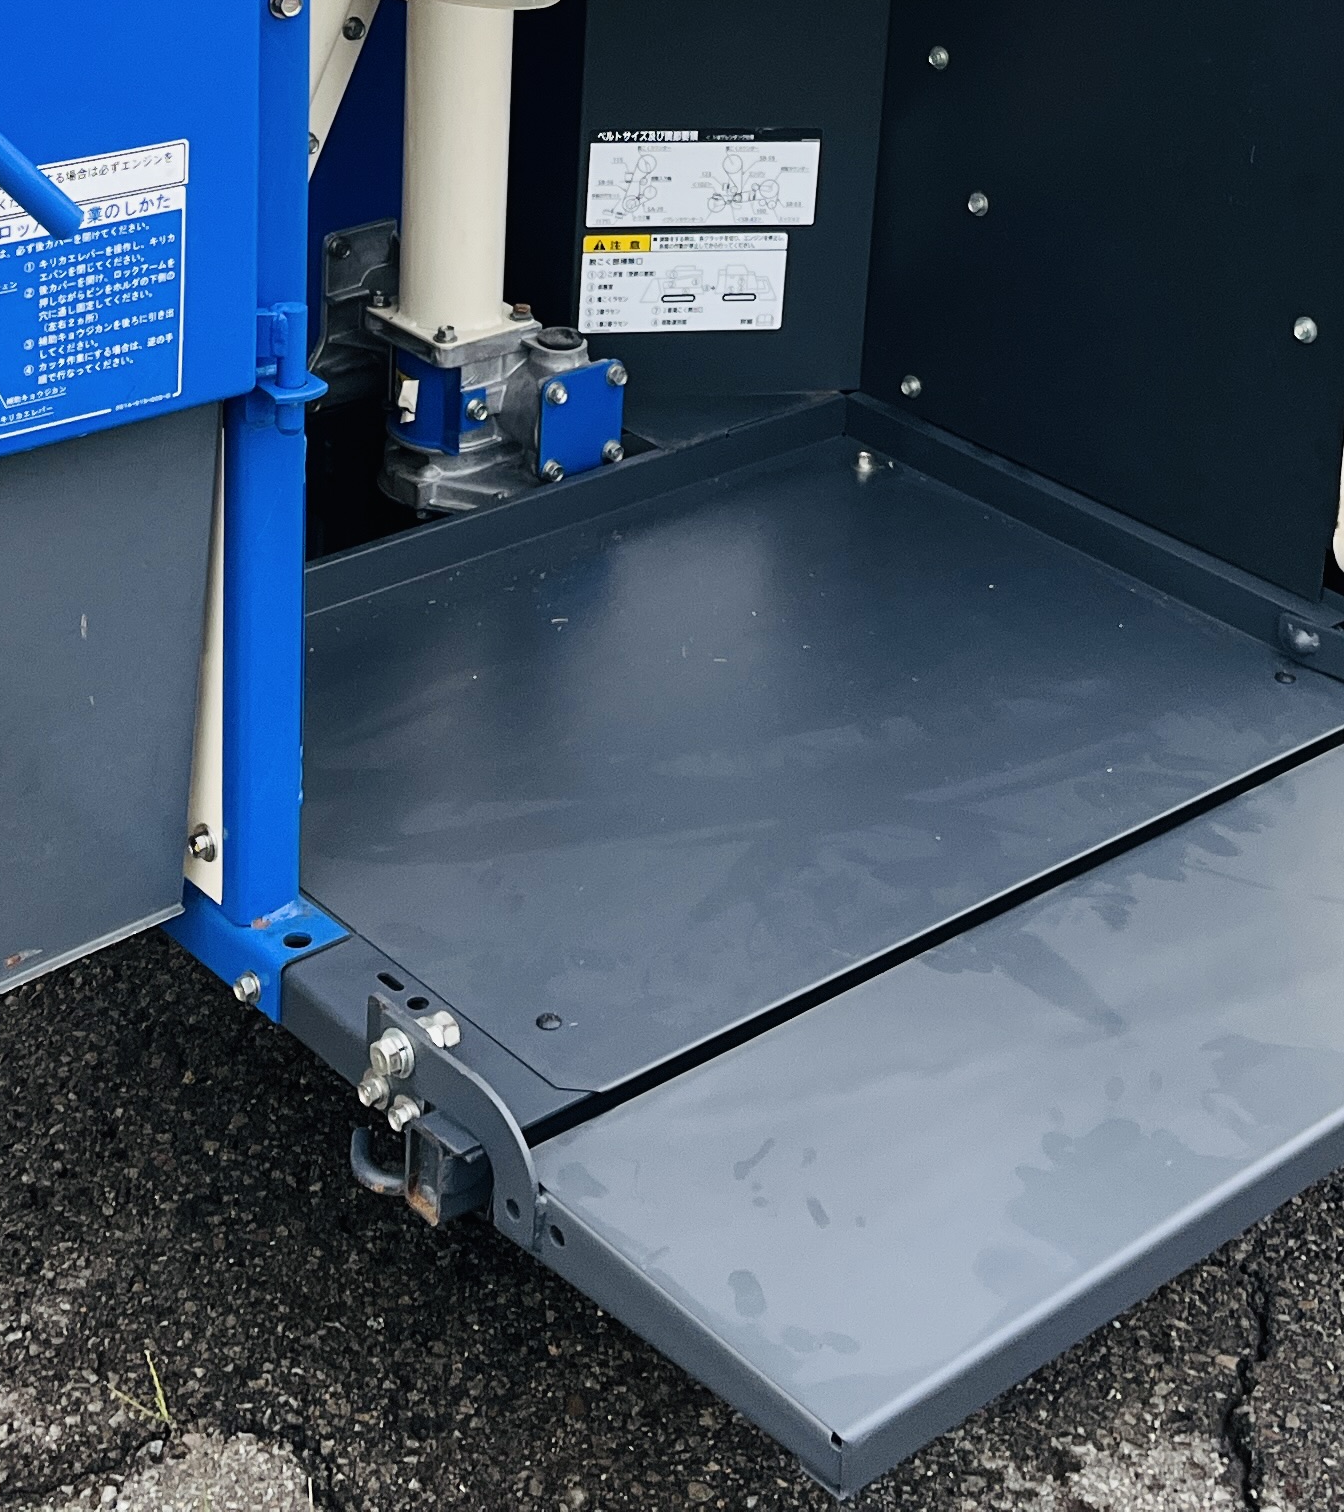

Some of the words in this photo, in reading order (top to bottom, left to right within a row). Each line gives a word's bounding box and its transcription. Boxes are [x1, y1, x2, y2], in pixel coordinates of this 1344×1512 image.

[45, 152, 173, 184] る場合は必ずエンジンを
[82, 194, 171, 224] 業のしかた
[609, 240, 641, 250] 注意
[38, 339, 99, 360] してください。
